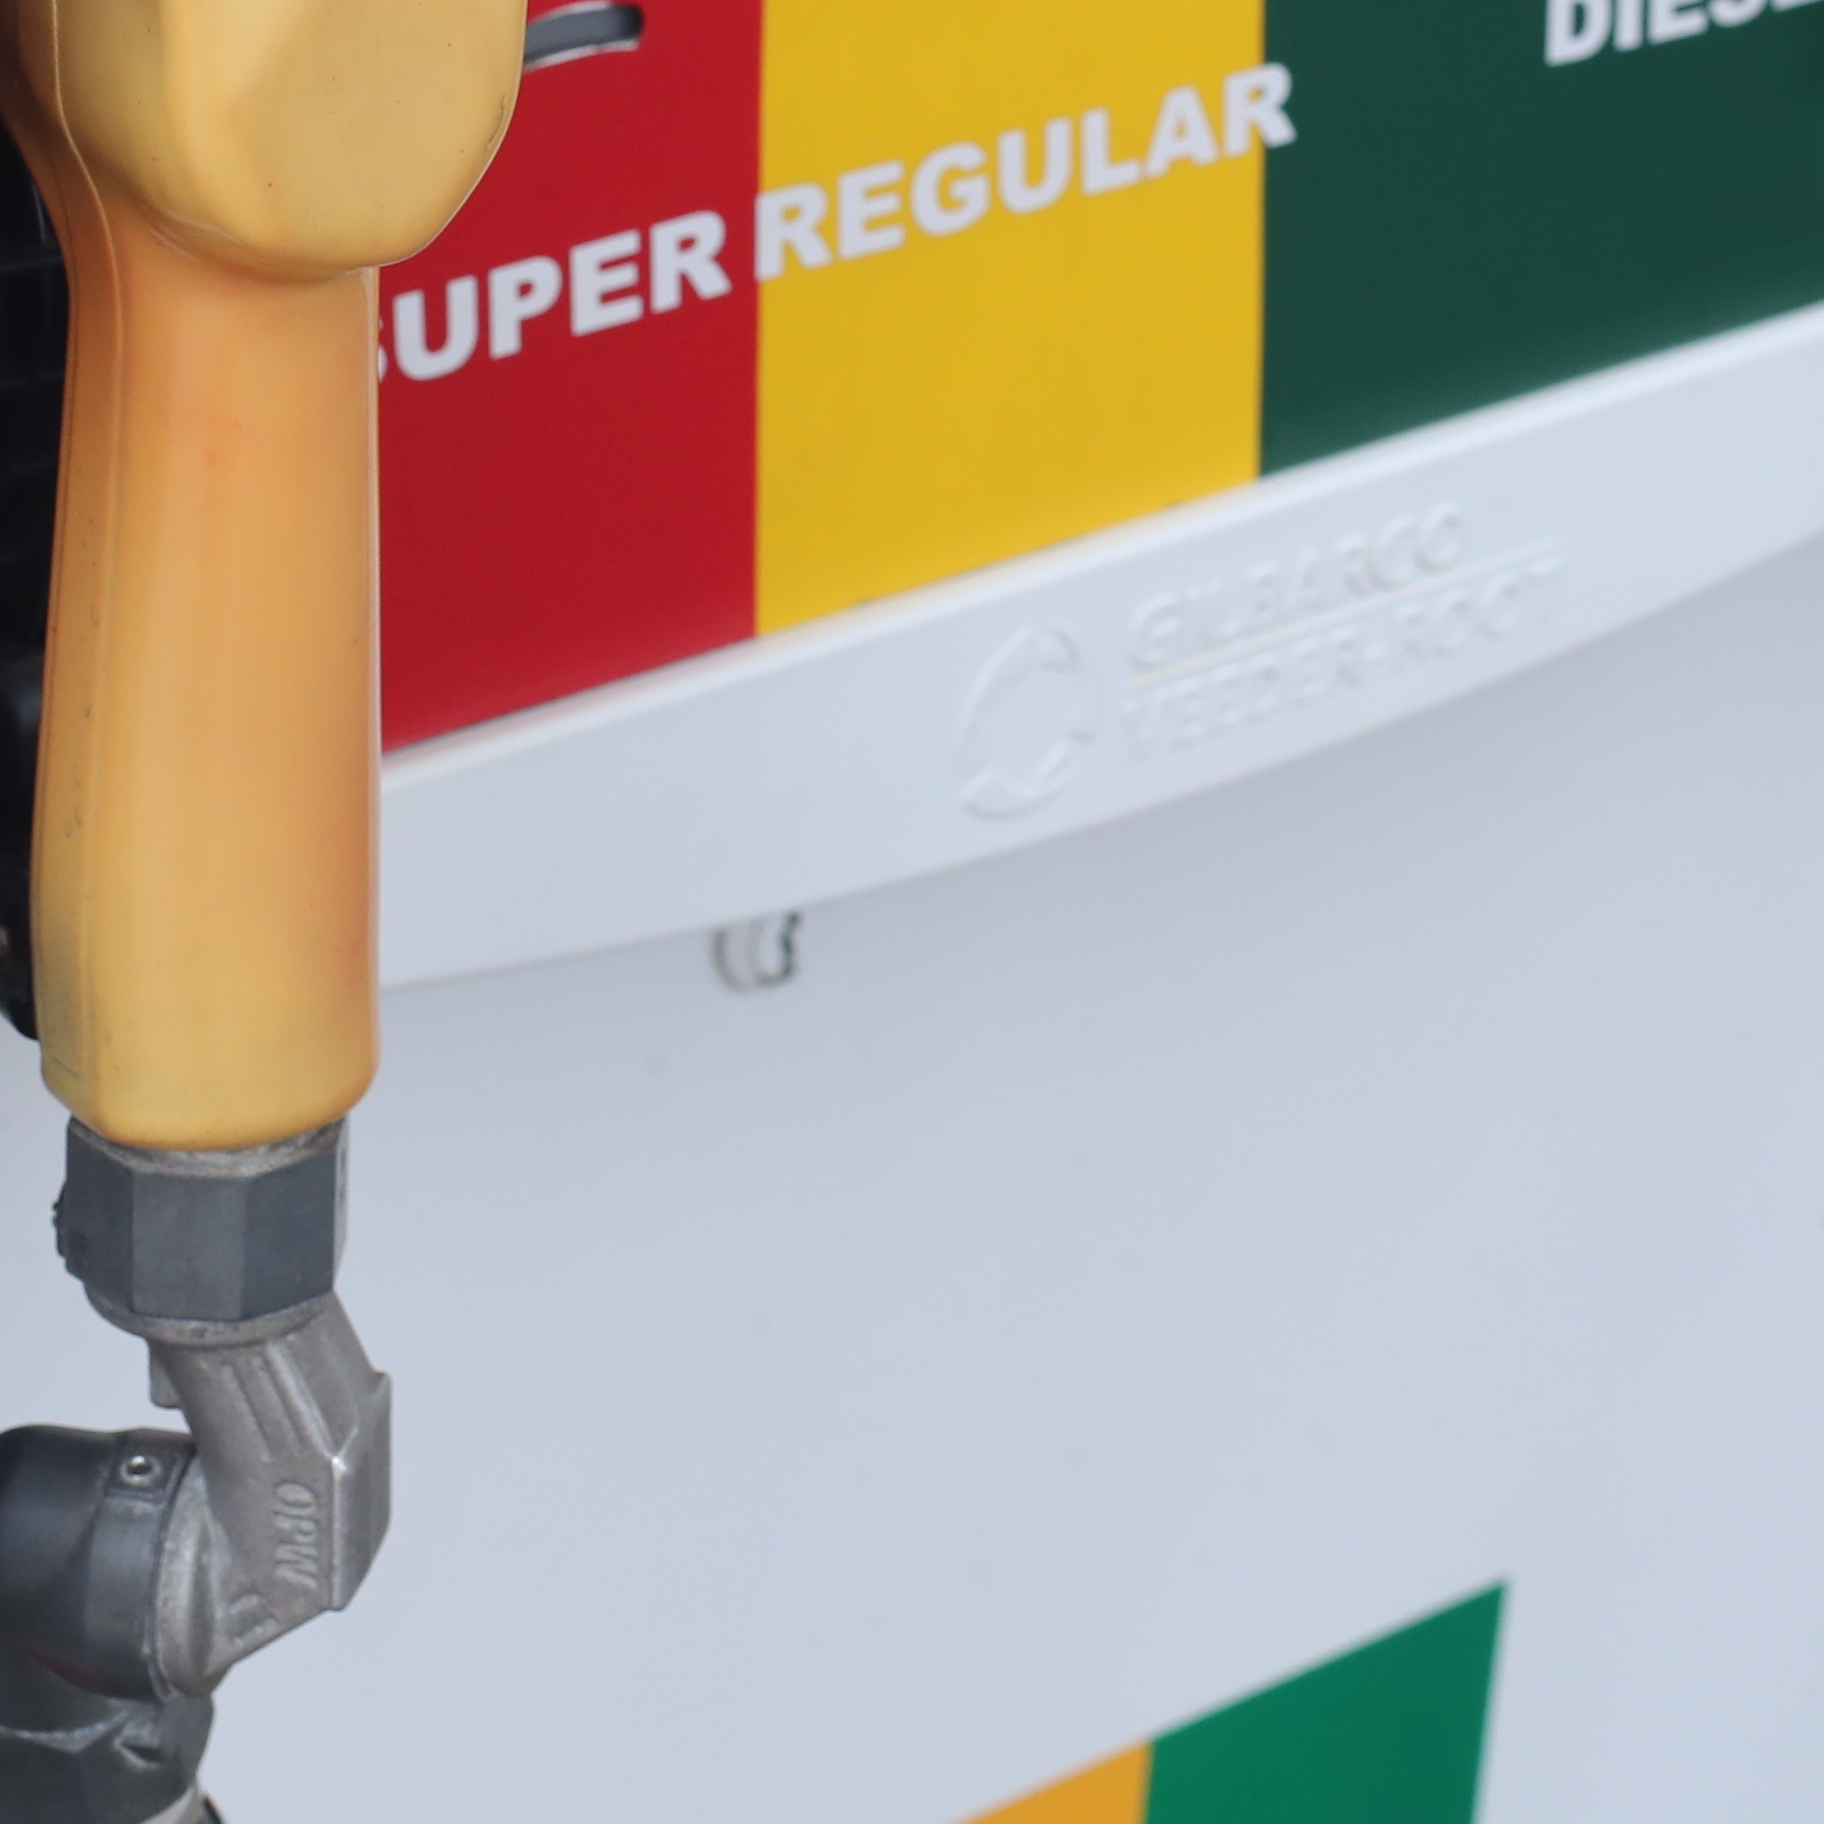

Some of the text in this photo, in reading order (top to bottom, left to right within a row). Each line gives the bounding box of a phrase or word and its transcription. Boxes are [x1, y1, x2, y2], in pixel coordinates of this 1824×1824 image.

[753, 61, 1298, 282] REGULAR
[377, 210, 732, 383] UPER
[274, 1480, 319, 1589] OPW
